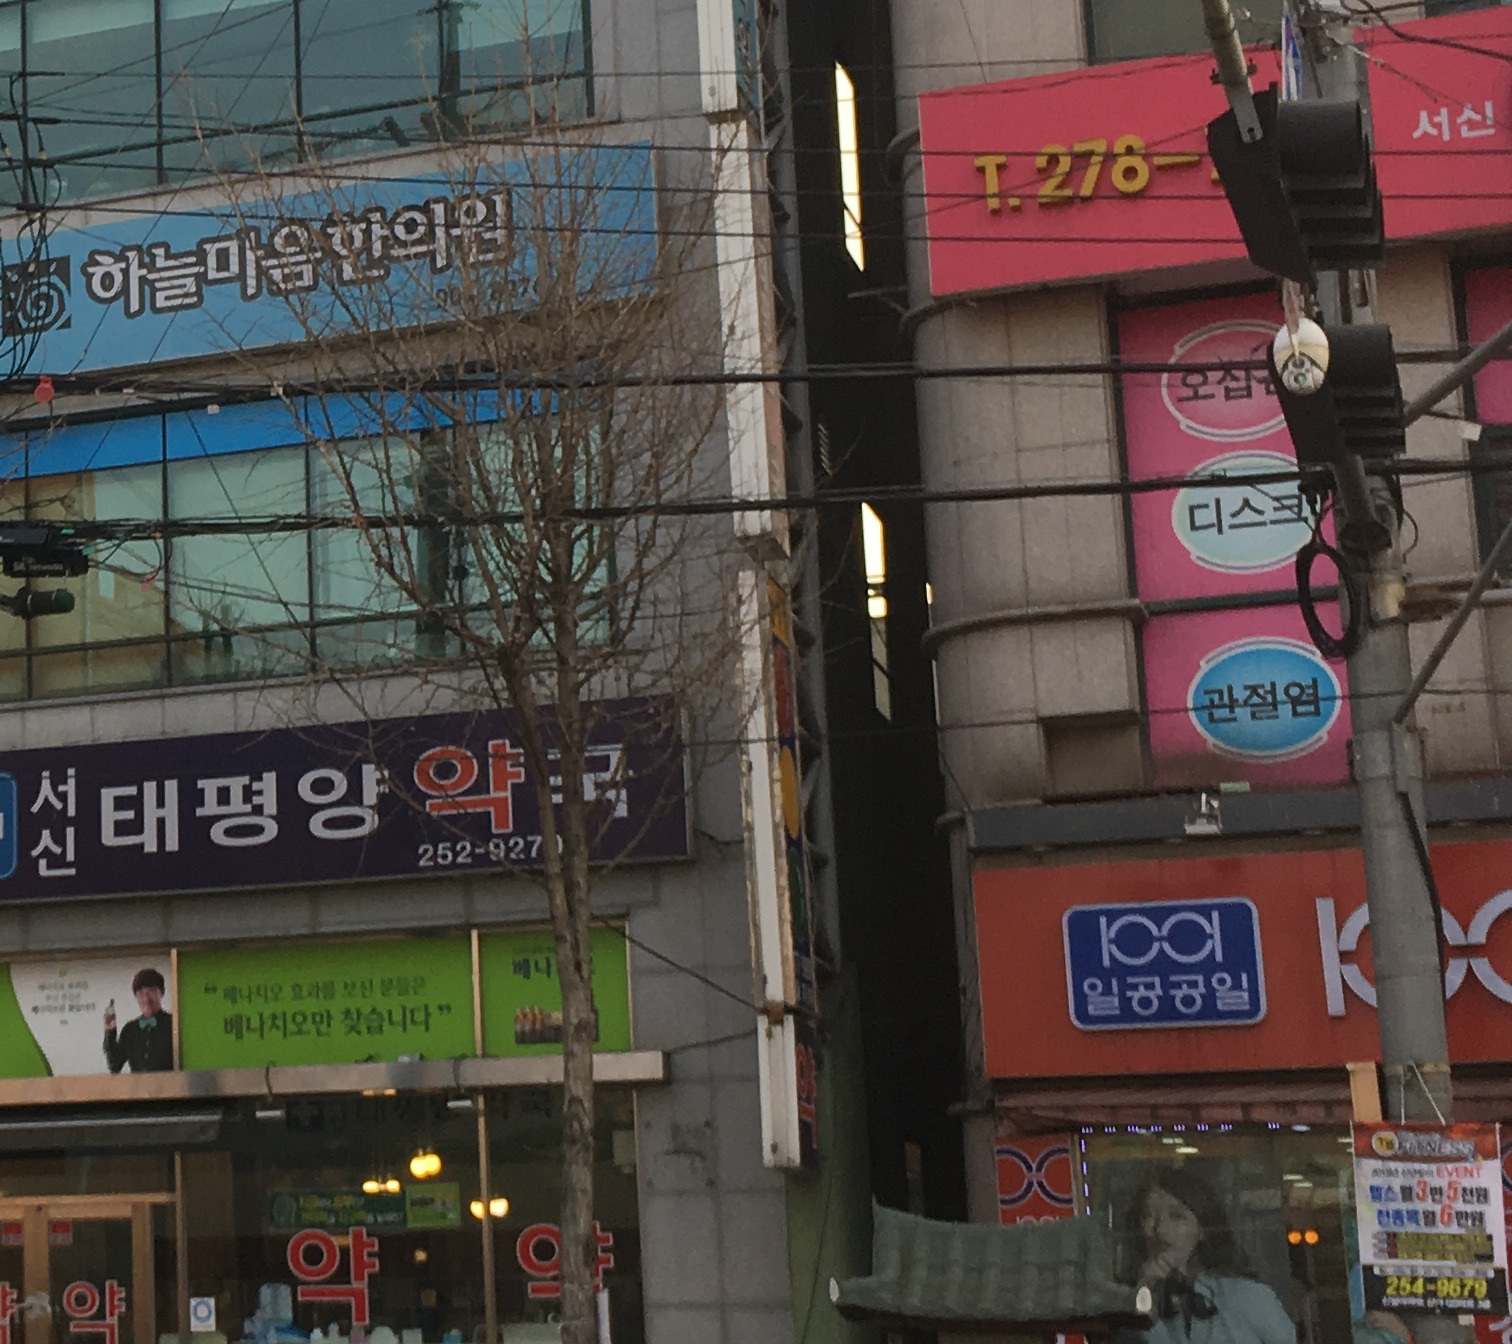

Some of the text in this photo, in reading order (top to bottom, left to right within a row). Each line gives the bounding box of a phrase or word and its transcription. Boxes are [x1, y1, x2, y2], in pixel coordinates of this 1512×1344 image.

[1412, 100, 1496, 143] 서신
[83, 188, 512, 318] 하늘마음한의원
[1188, 493, 1310, 537] 디스크
[1201, 678, 1322, 724] 관절염
[29, 768, 78, 878] 서신
[1083, 972, 1249, 1016] 일공공일
[288, 1226, 379, 1325] 약
